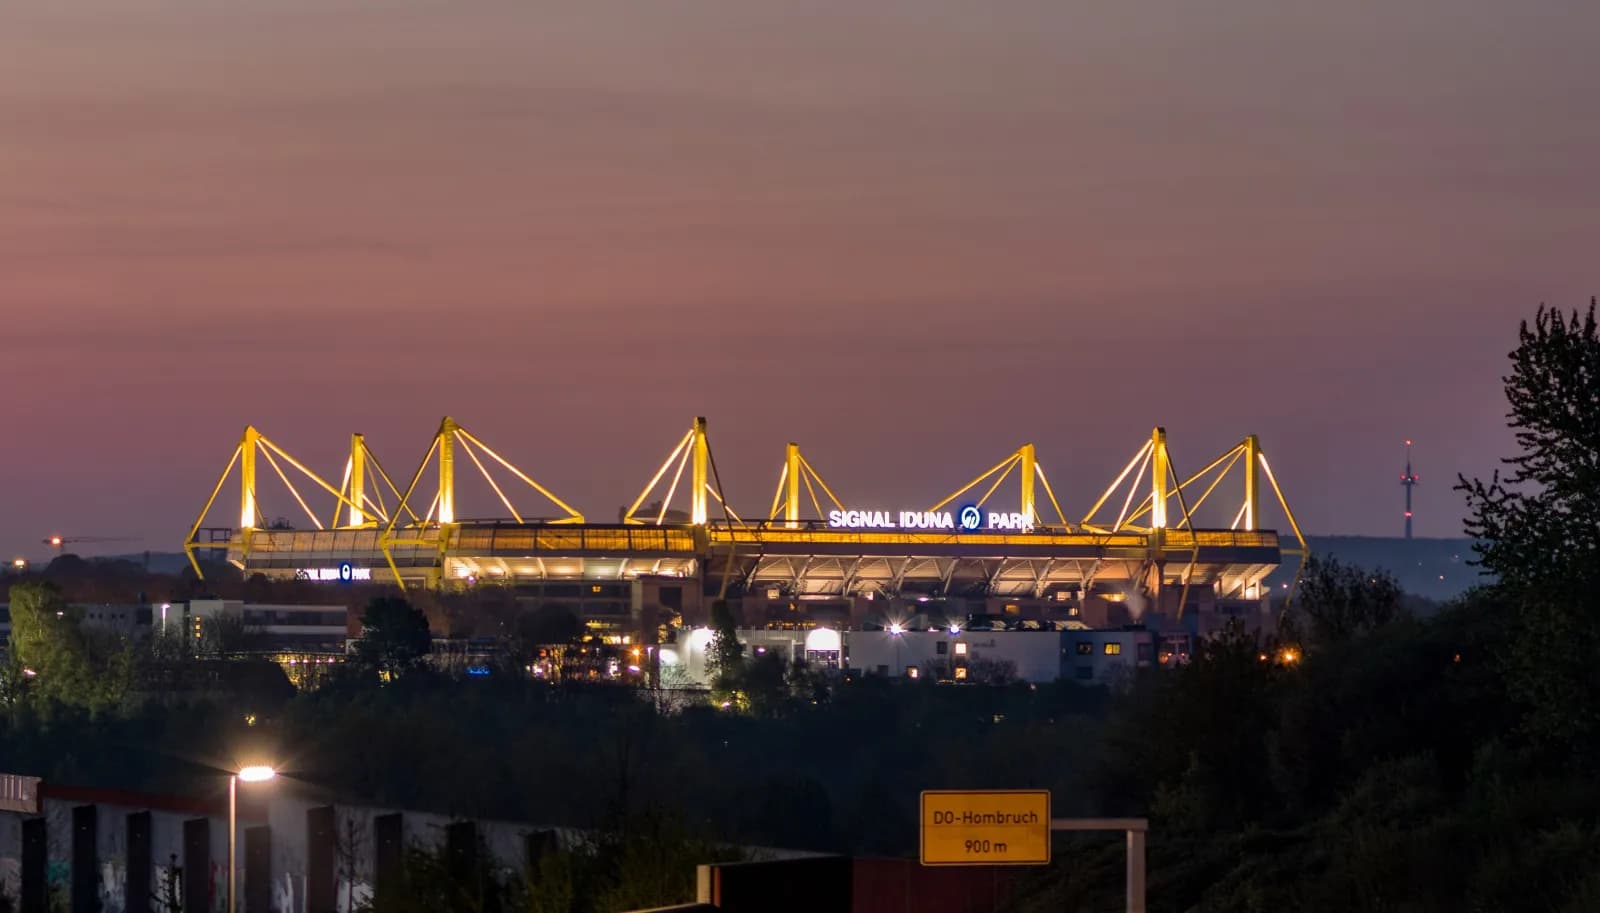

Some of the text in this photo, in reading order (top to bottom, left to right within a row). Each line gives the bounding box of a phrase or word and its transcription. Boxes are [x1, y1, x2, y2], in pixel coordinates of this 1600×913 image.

[829, 510, 1034, 529] SIGNAL IDUNA PARK
[934, 811, 1038, 825] DO-Hombruch
[965, 839, 1008, 853] 900 m
